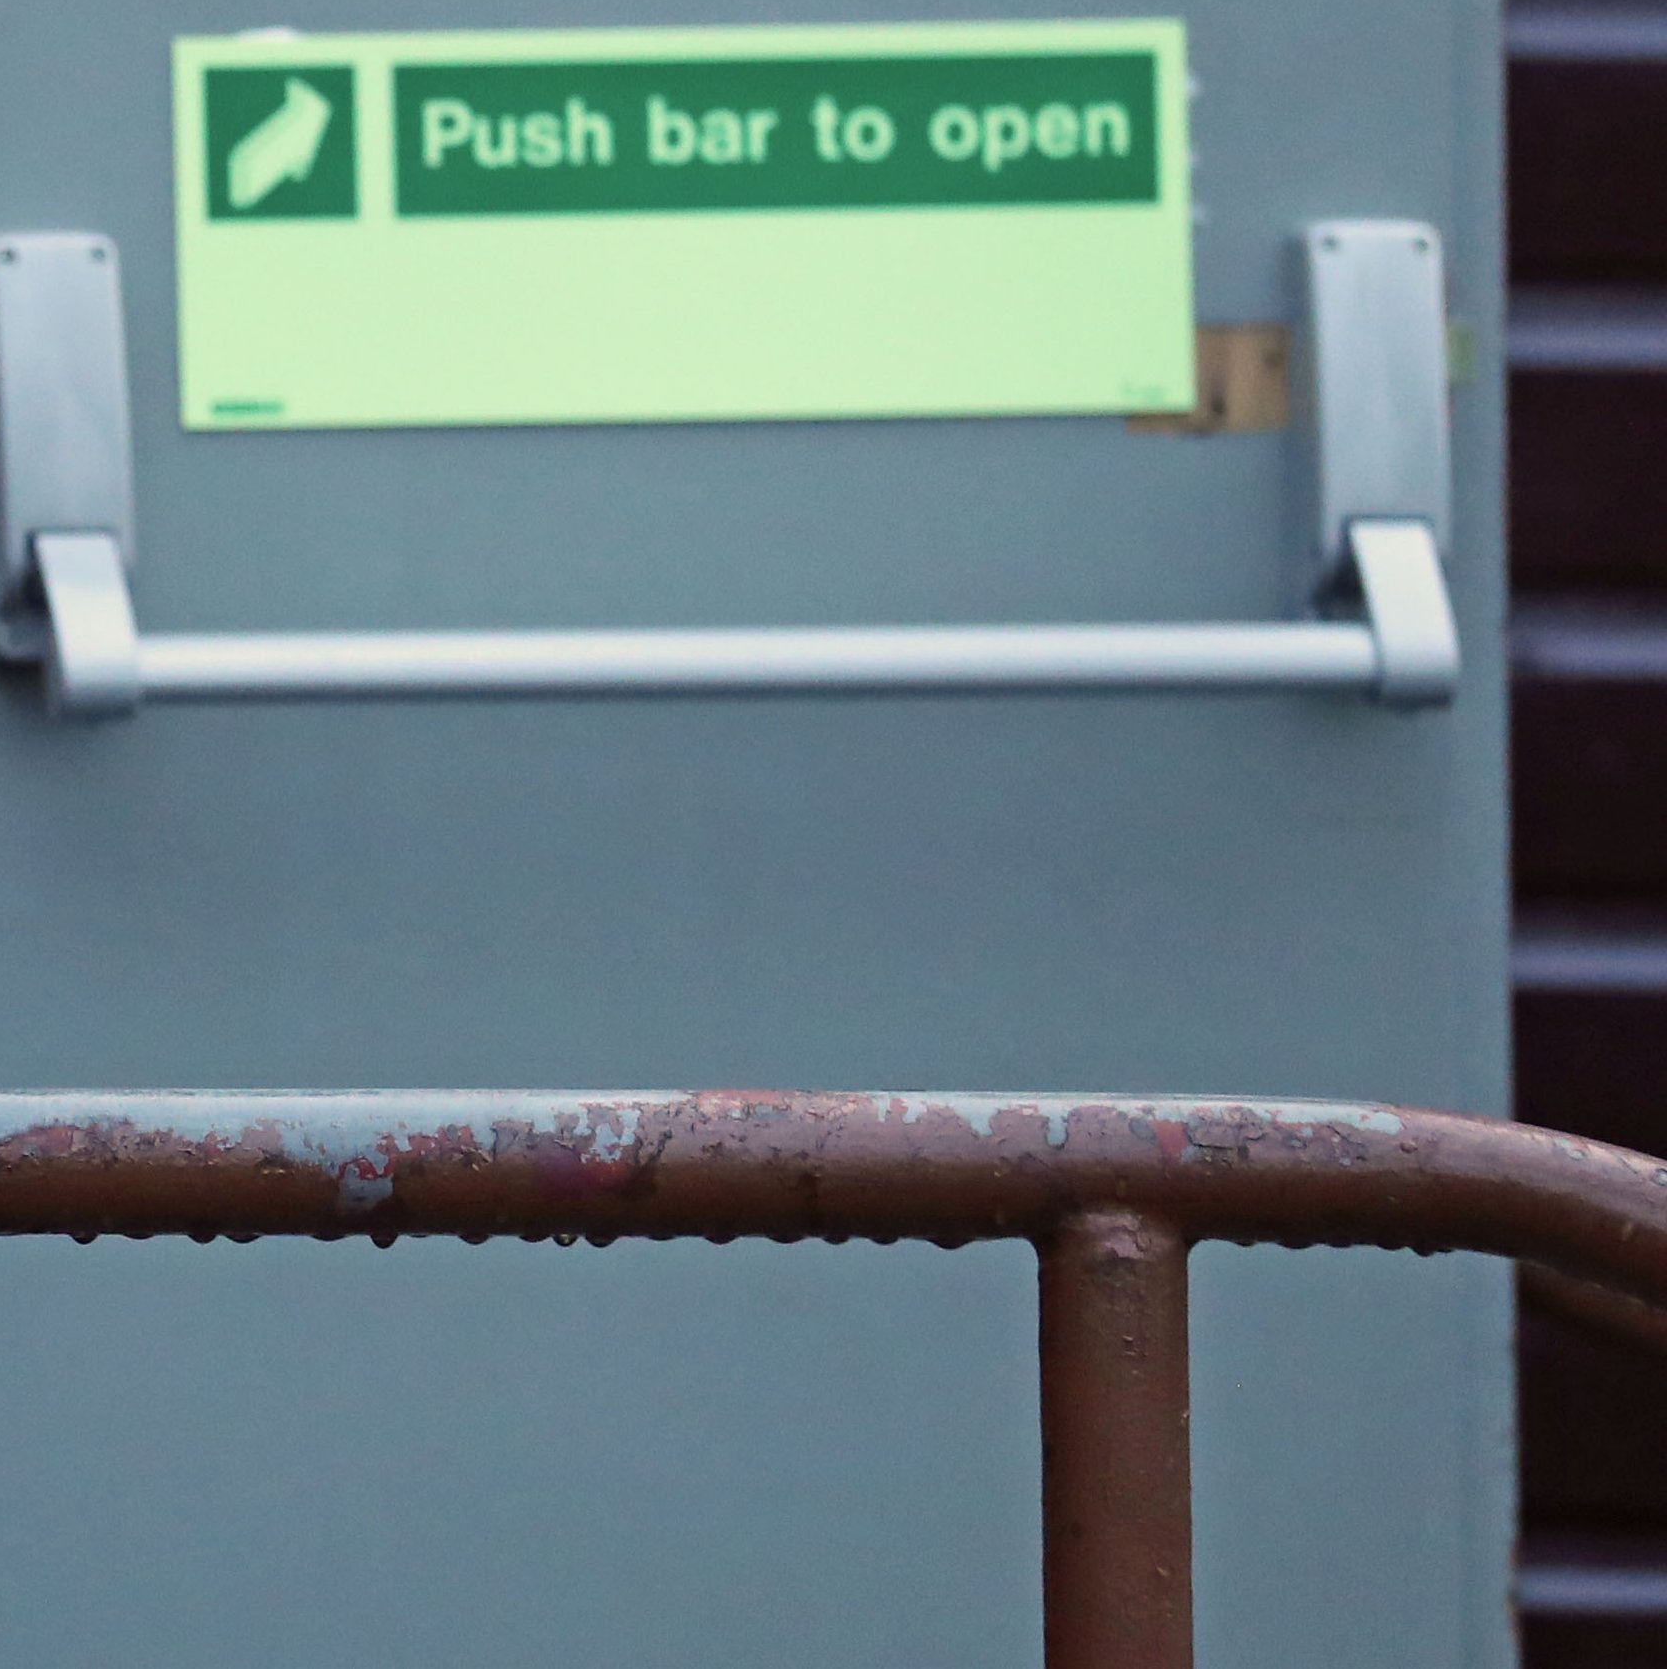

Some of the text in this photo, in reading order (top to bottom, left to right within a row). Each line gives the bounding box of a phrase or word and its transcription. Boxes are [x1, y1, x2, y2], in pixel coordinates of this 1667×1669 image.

[421, 95, 1132, 173] Push bar to open
